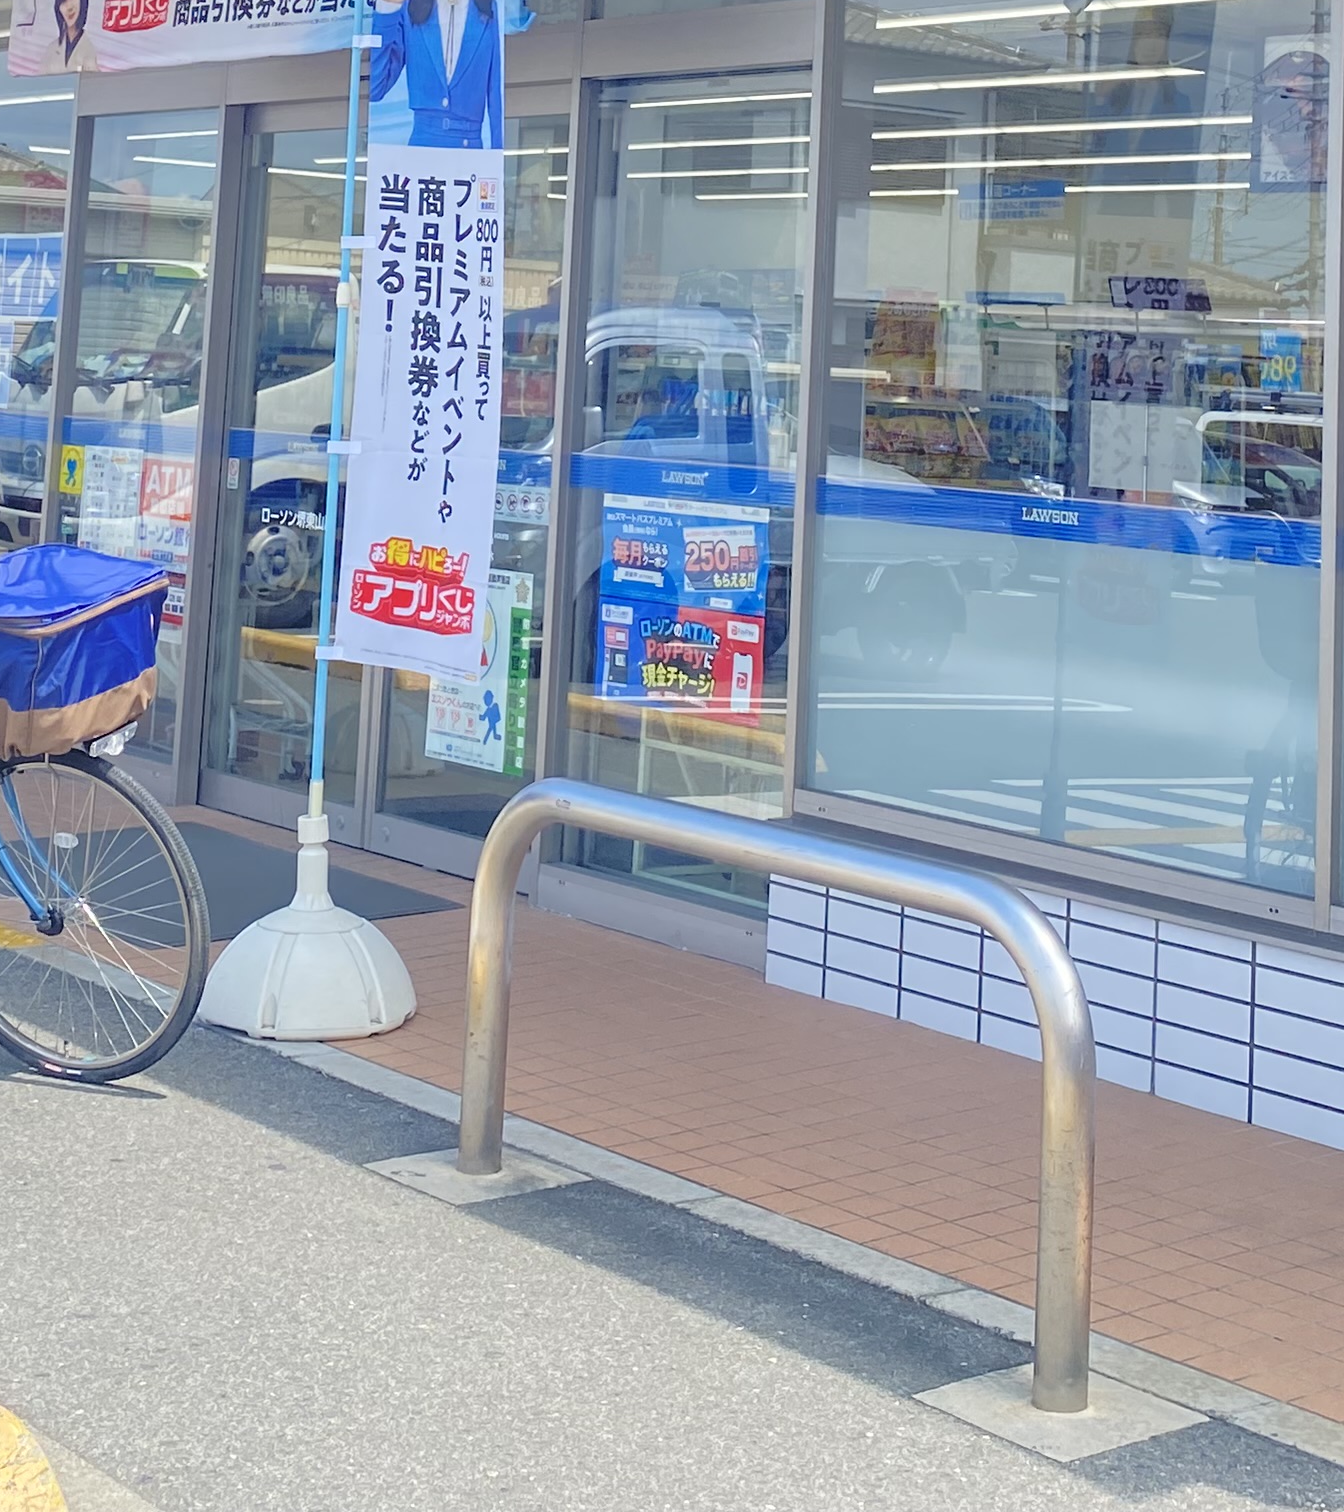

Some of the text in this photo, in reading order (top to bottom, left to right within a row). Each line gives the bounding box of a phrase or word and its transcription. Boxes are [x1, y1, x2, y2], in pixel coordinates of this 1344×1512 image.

[376, 174, 411, 332] 当たる!
[407, 176, 446, 481] 商品引換券などが
[438, 174, 476, 523] プレミアムイベントや
[146, 465, 193, 497] ATM
[662, 470, 705, 486] LAWSON
[1022, 507, 1079, 525] LAWSON
[613, 538, 668, 566] 毎月 もらえる
[642, 556, 668, 568] クーポン
[353, 573, 474, 621] ローソン アプリくじ
[436, 609, 472, 631] ジャンボ
[641, 619, 721, 649] ローソンのATMで
[645, 639, 714, 670] PayPayに
[641, 662, 715, 699] 現金チャージ!
